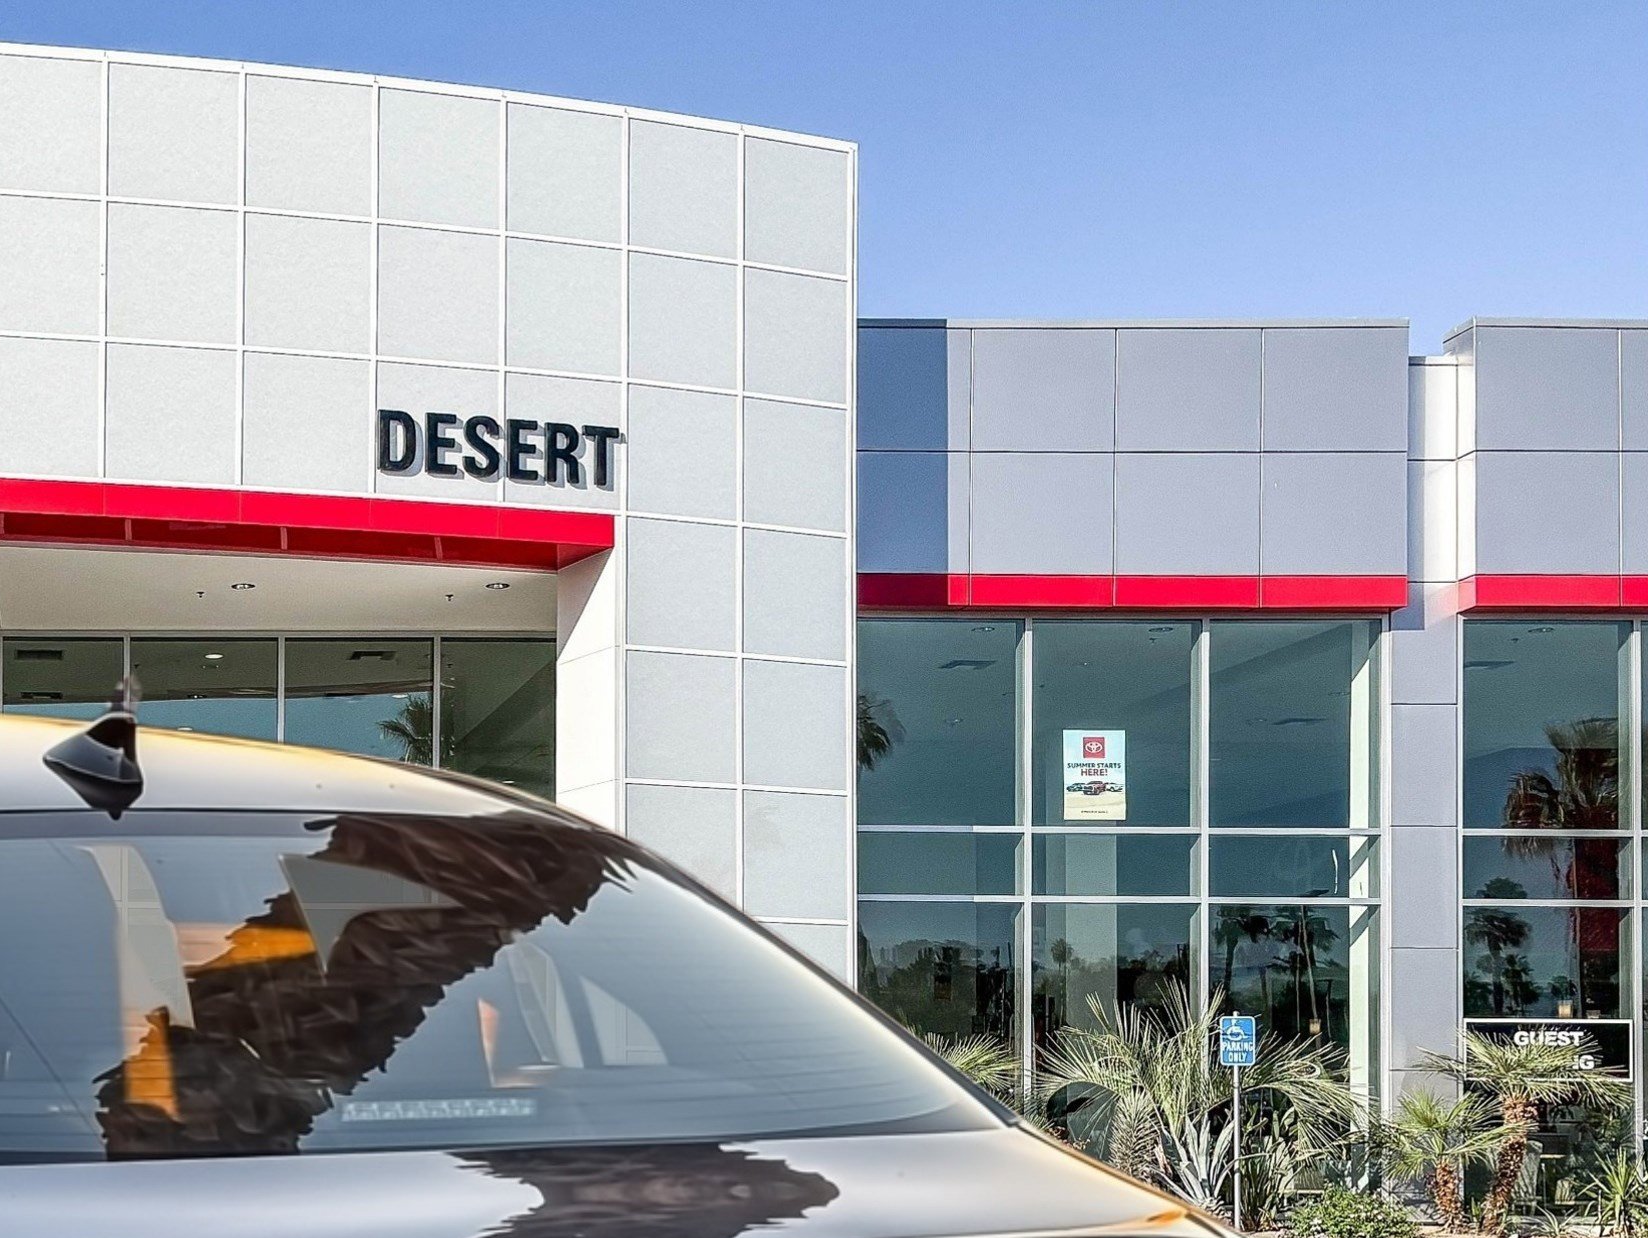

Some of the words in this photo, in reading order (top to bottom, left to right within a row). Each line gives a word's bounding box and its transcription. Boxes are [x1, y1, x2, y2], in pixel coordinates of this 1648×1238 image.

[377, 409, 621, 487] DESERT
[1513, 1031, 1584, 1046] GUEST
[1222, 1041, 1253, 1051] PARKING
[1228, 1052, 1247, 1062] ONLY
